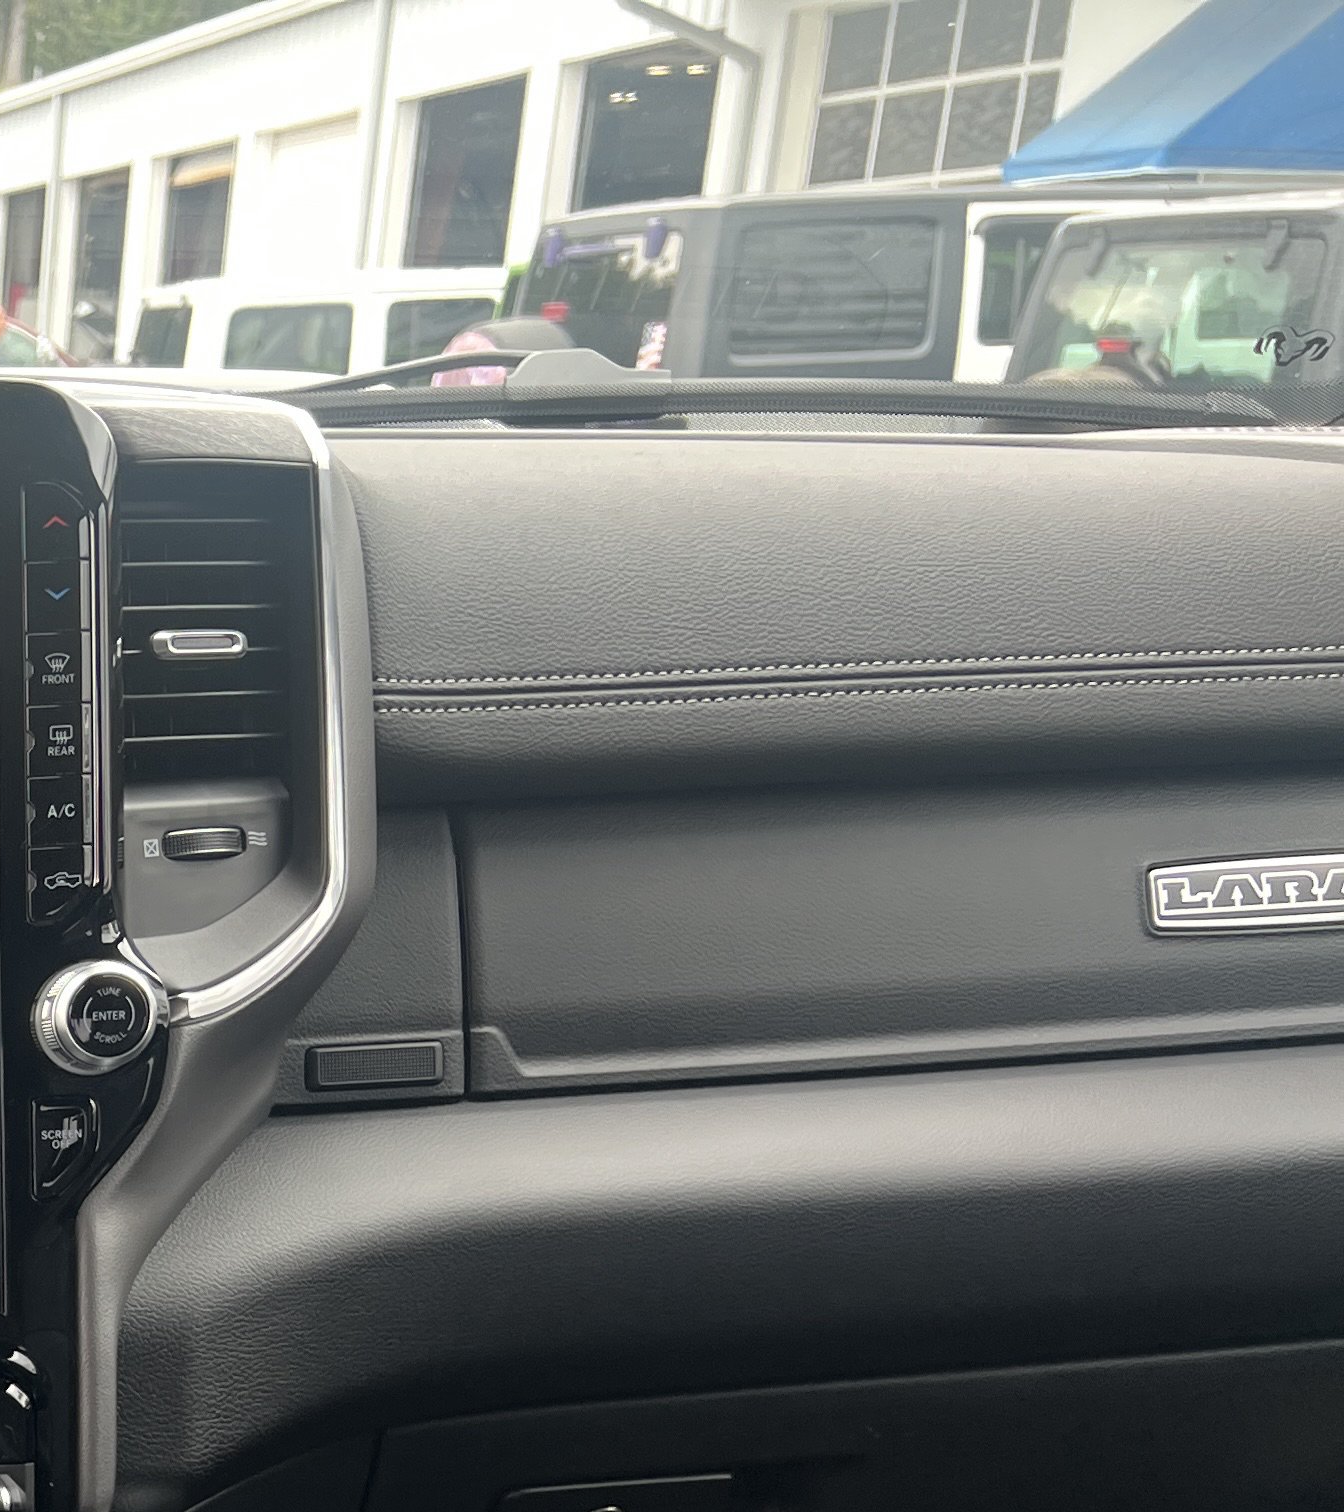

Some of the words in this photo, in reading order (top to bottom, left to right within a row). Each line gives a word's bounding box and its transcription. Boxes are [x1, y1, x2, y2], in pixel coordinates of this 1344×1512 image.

[42, 674, 74, 685] FRONT
[48, 746, 75, 756] REAR
[48, 803, 75, 818] A/C
[96, 986, 122, 997] TUNE
[92, 1010, 126, 1021] ENTER
[94, 1031, 128, 1044] SCROLL
[41, 1129, 82, 1139] SCREEN
